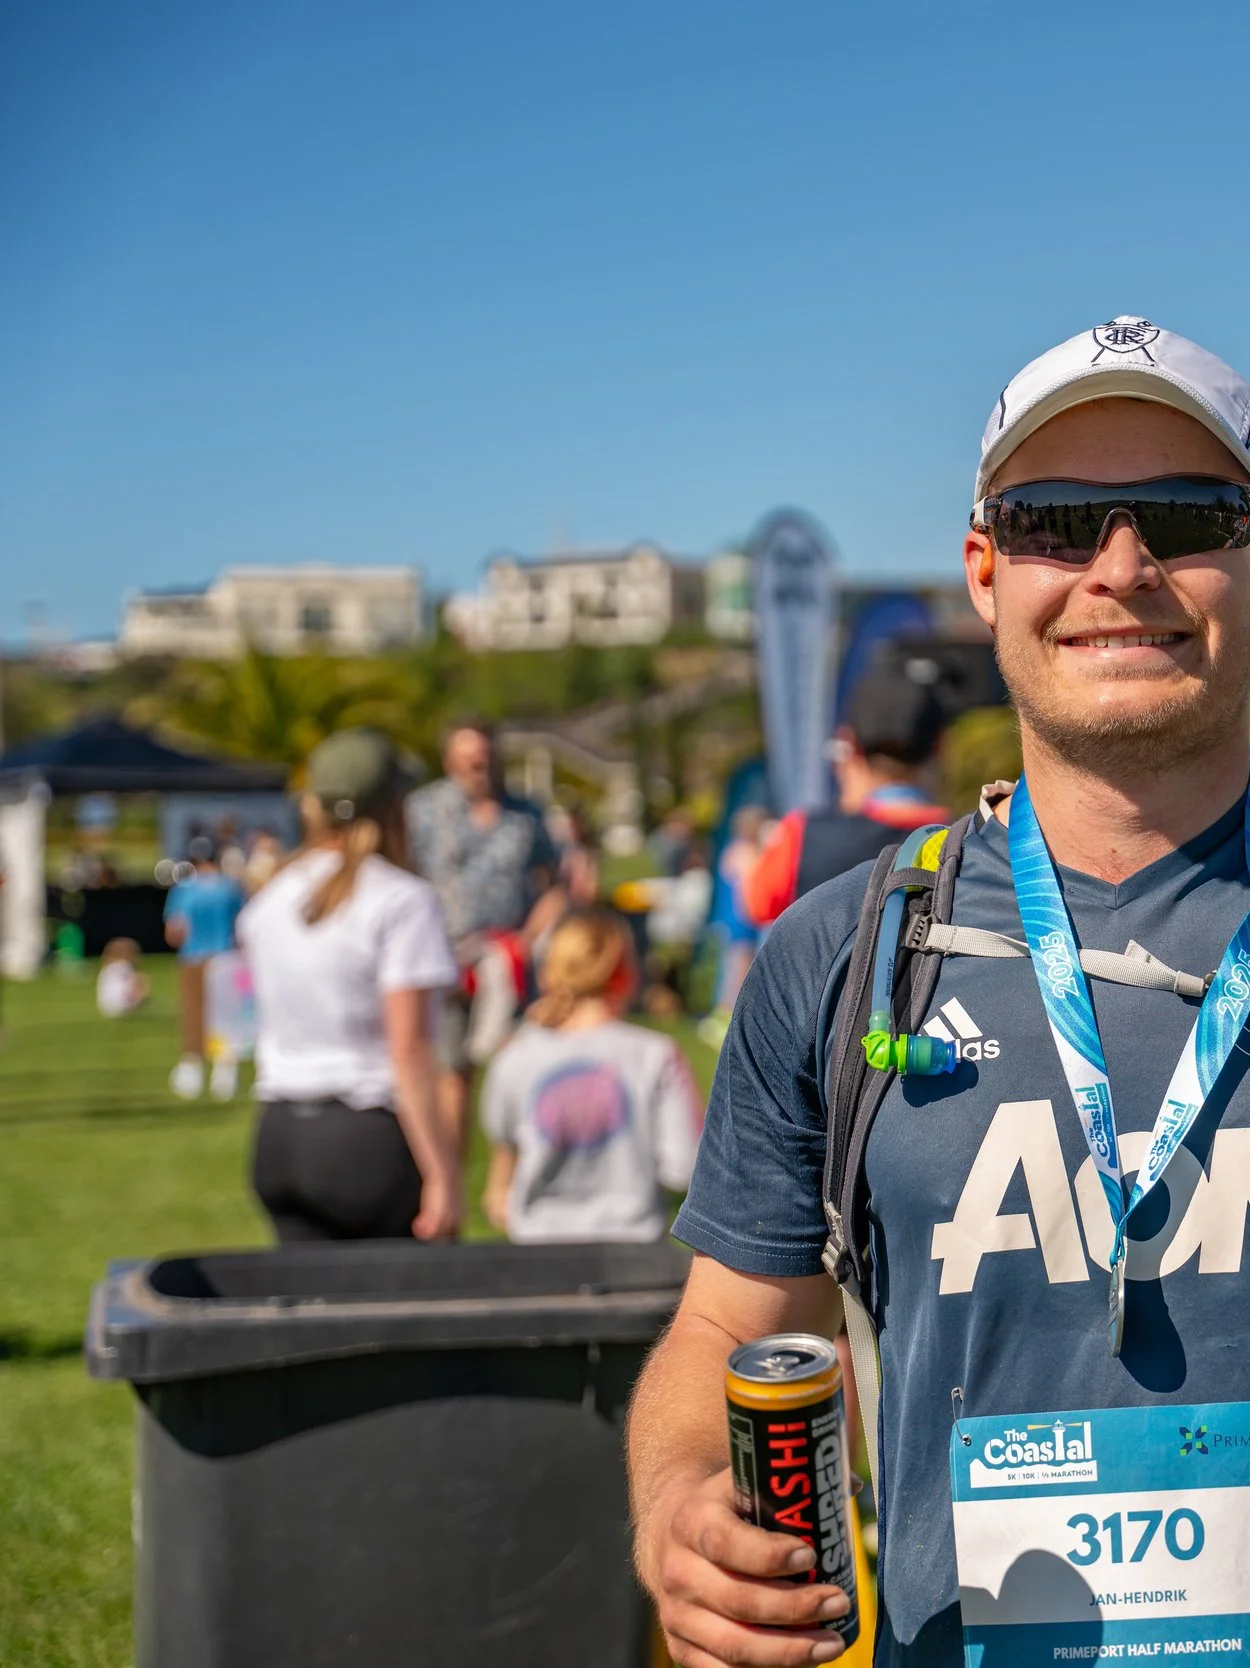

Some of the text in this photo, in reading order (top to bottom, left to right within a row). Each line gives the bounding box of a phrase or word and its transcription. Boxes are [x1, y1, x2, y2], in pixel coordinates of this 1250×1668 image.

[1039, 932, 1079, 998] 2025
[1074, 1086, 1109, 1158] Coastal
[1148, 1099, 1187, 1171] Coastal
[984, 1419, 1093, 1465] Coastal
[1003, 1429, 1029, 1443] The
[1051, 1469, 1093, 1478] MARATHON
[815, 1434, 851, 1574] SHRED
[1066, 1507, 1206, 1567] 3170
[1089, 1589, 1188, 1607] JAN-HENDRIK
[1053, 1638, 1242, 1660] PRIMEPORT HALF MARATHON
